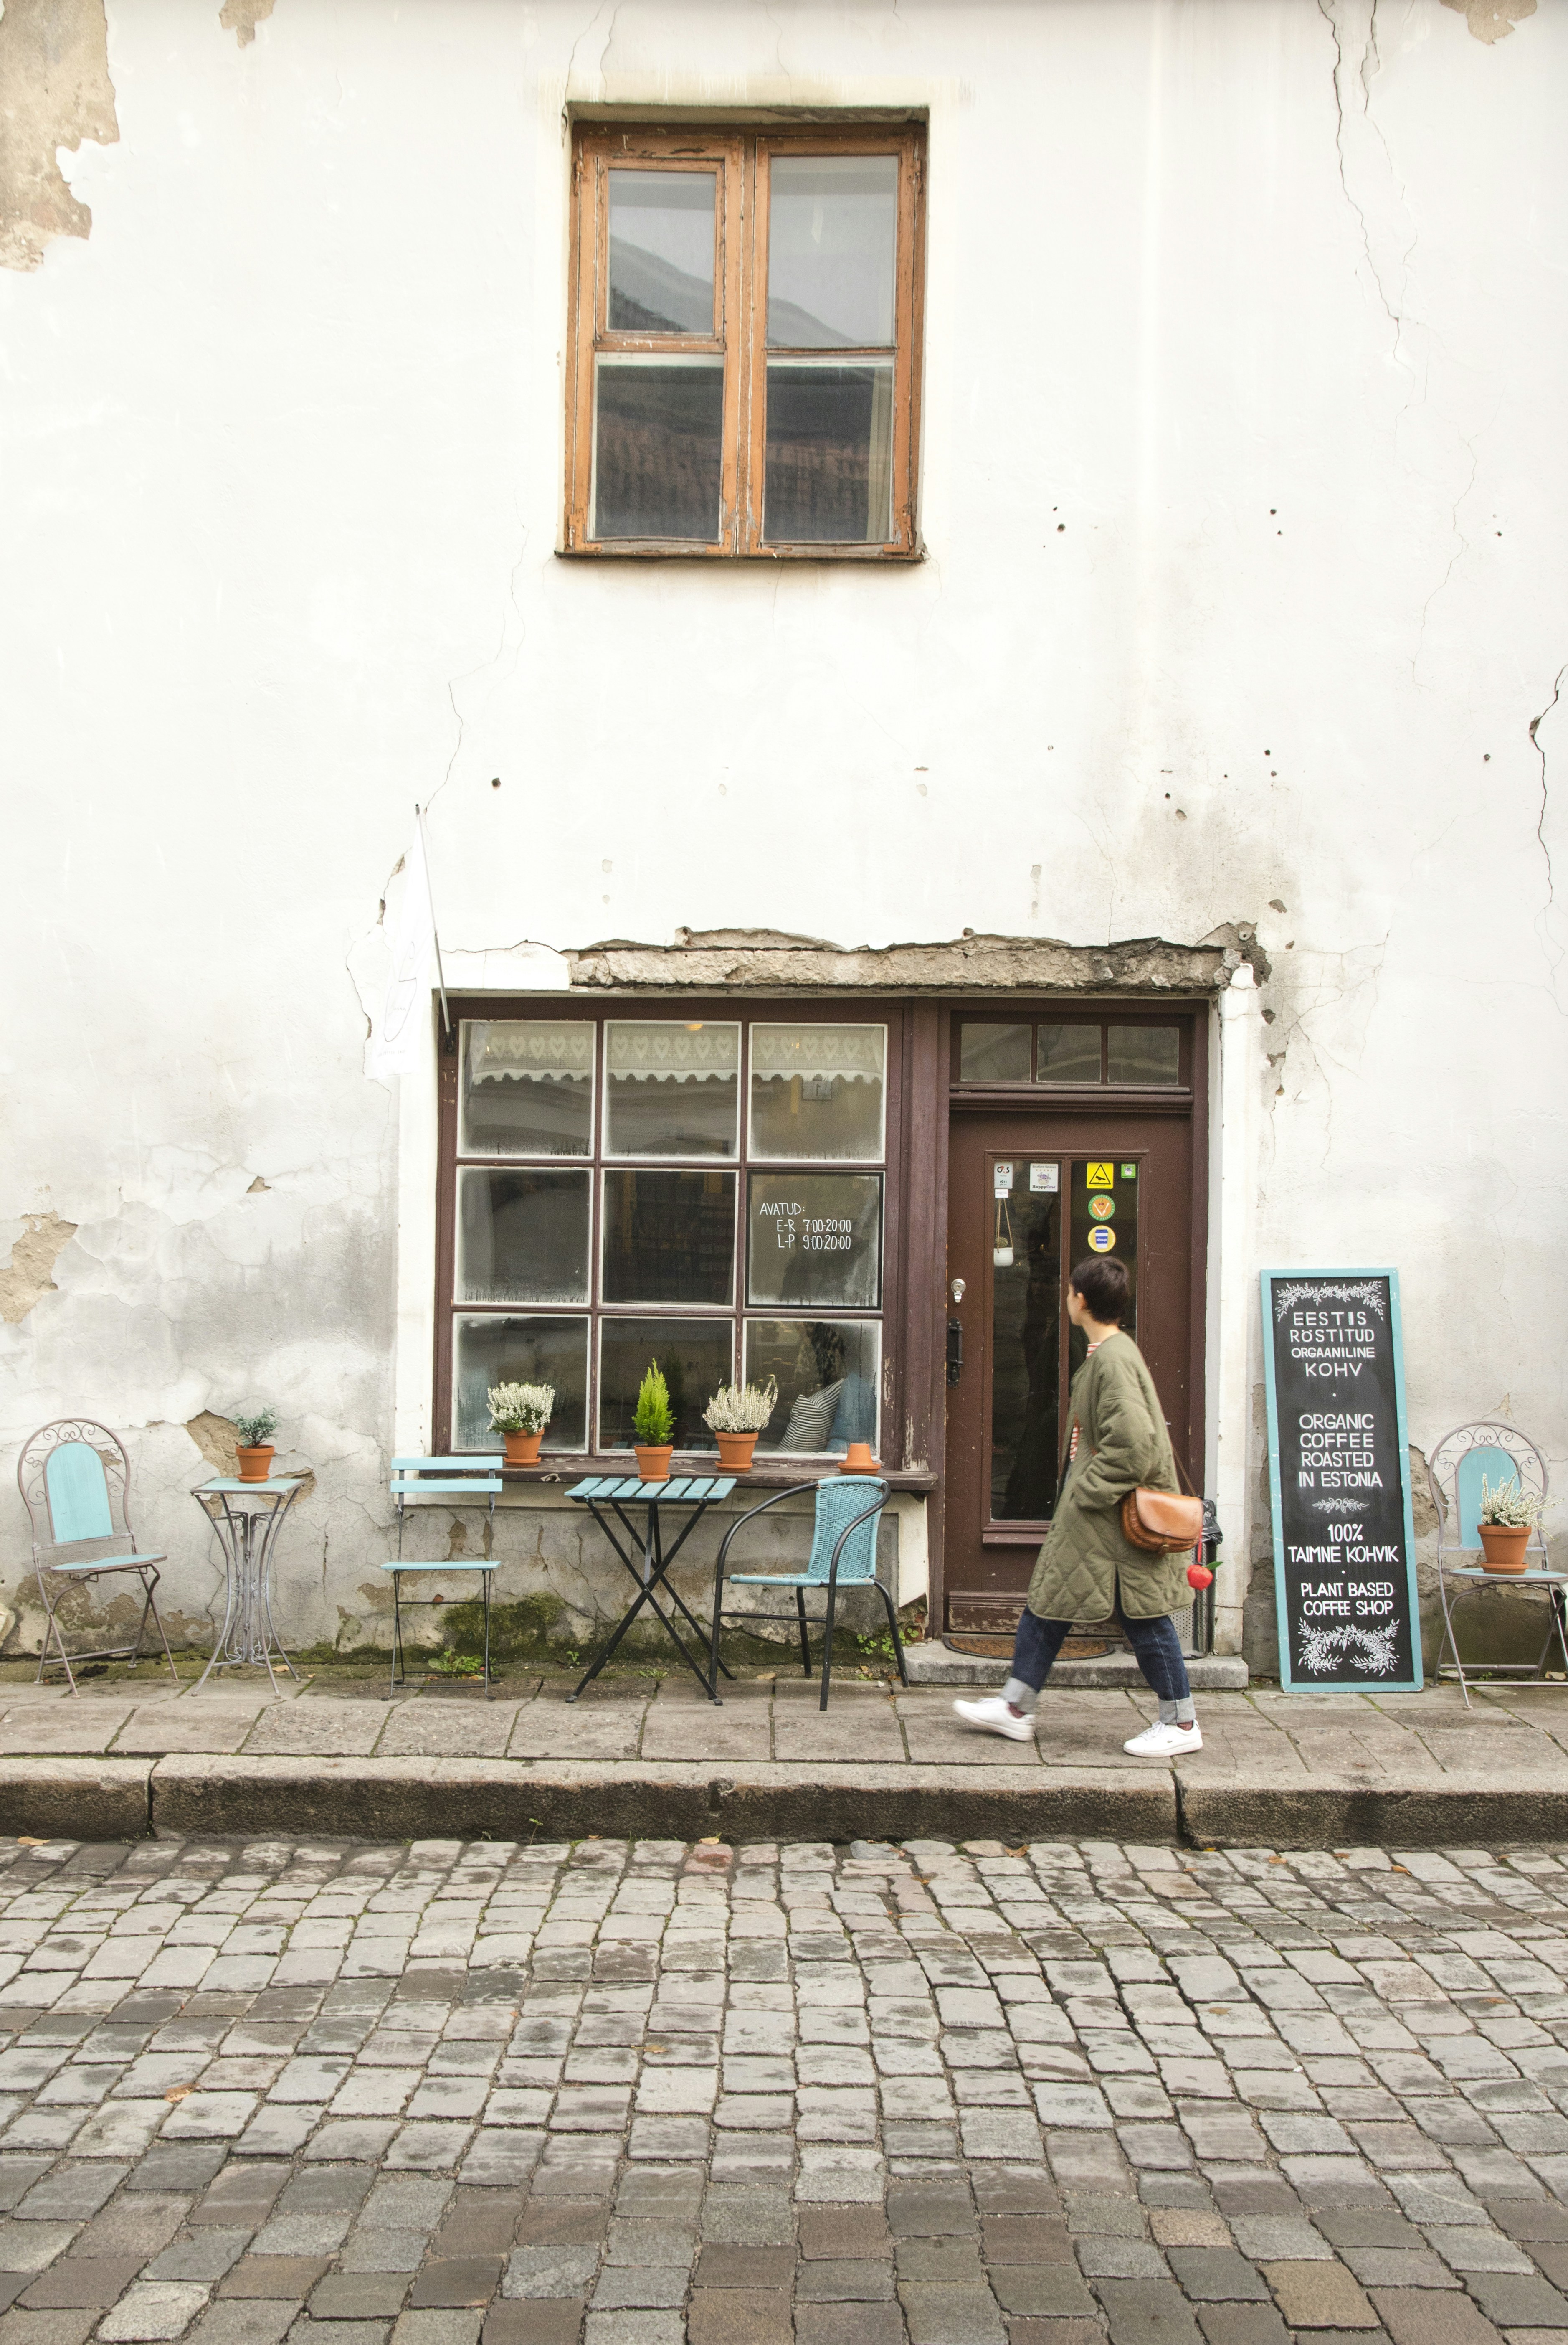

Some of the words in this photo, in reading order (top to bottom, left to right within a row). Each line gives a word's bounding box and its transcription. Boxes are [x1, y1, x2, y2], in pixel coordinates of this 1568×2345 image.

[759, 1202, 805, 1215] AVATUD:
[776, 1219, 796, 1232] E-R
[803, 1218, 851, 1233] 7:00-20:00
[778, 1234, 795, 1249] L-P
[803, 1234, 851, 1250] 9:00-20:00
[1293, 1311, 1367, 1326] EESTIS
[1290, 1328, 1375, 1343] RÖSTITUD
[1291, 1347, 1375, 1358] ORGAANILINE
[1305, 1362, 1363, 1377] KOHV
[1299, 1413, 1374, 1429] ORGANIC
[1300, 1433, 1374, 1448] COFFEE
[1301, 1452, 1374, 1467] ROASTED
[1298, 1471, 1315, 1487] IN
[1320, 1471, 1383, 1487] ESTONIA
[1327, 1523, 1363, 1542] 100%
[1287, 1546, 1341, 1563] TAIMNE
[1346, 1546, 1399, 1563] KOHVIK
[1300, 1582, 1344, 1597] PLANT
[1348, 1582, 1393, 1597] BASED
[1303, 1600, 1351, 1616] COFFEE
[1355, 1600, 1393, 1615] SHOP
